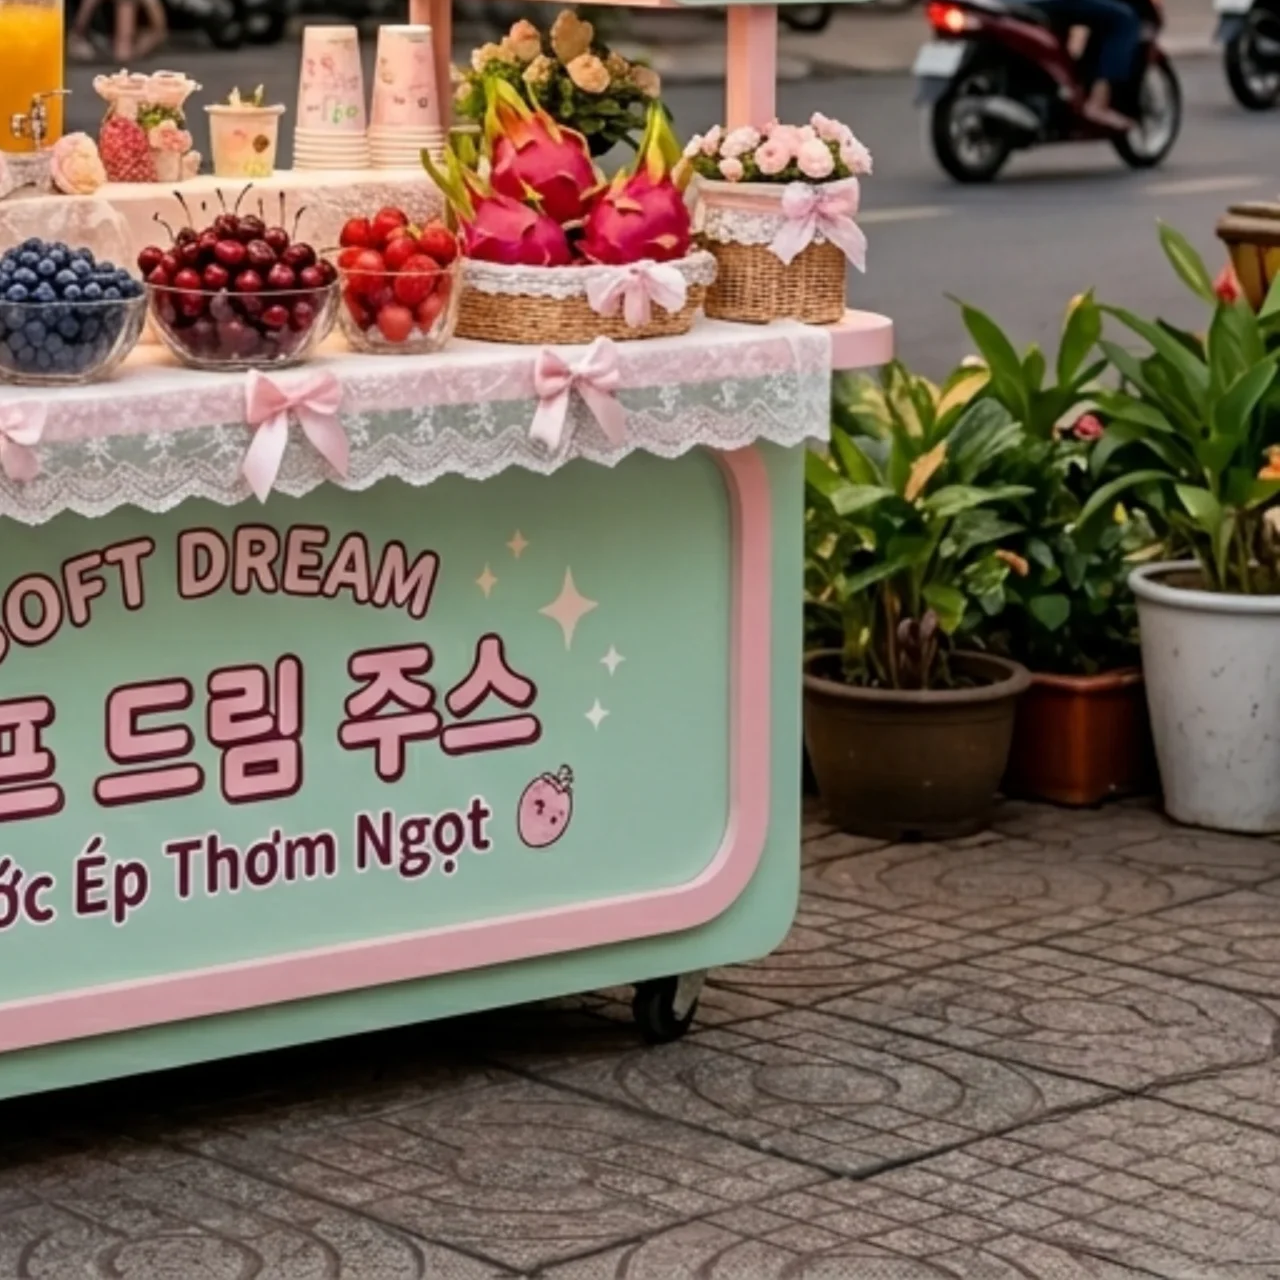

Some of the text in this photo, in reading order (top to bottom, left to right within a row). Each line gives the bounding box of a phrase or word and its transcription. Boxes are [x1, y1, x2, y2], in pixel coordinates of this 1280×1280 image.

[176, 523, 440, 620] DREAM
[94, 652, 304, 808] 드림
[336, 632, 543, 784] 주스
[75, 835, 150, 925] Ép
[164, 828, 338, 899] Thơm
[355, 796, 492, 879] Ngọt
